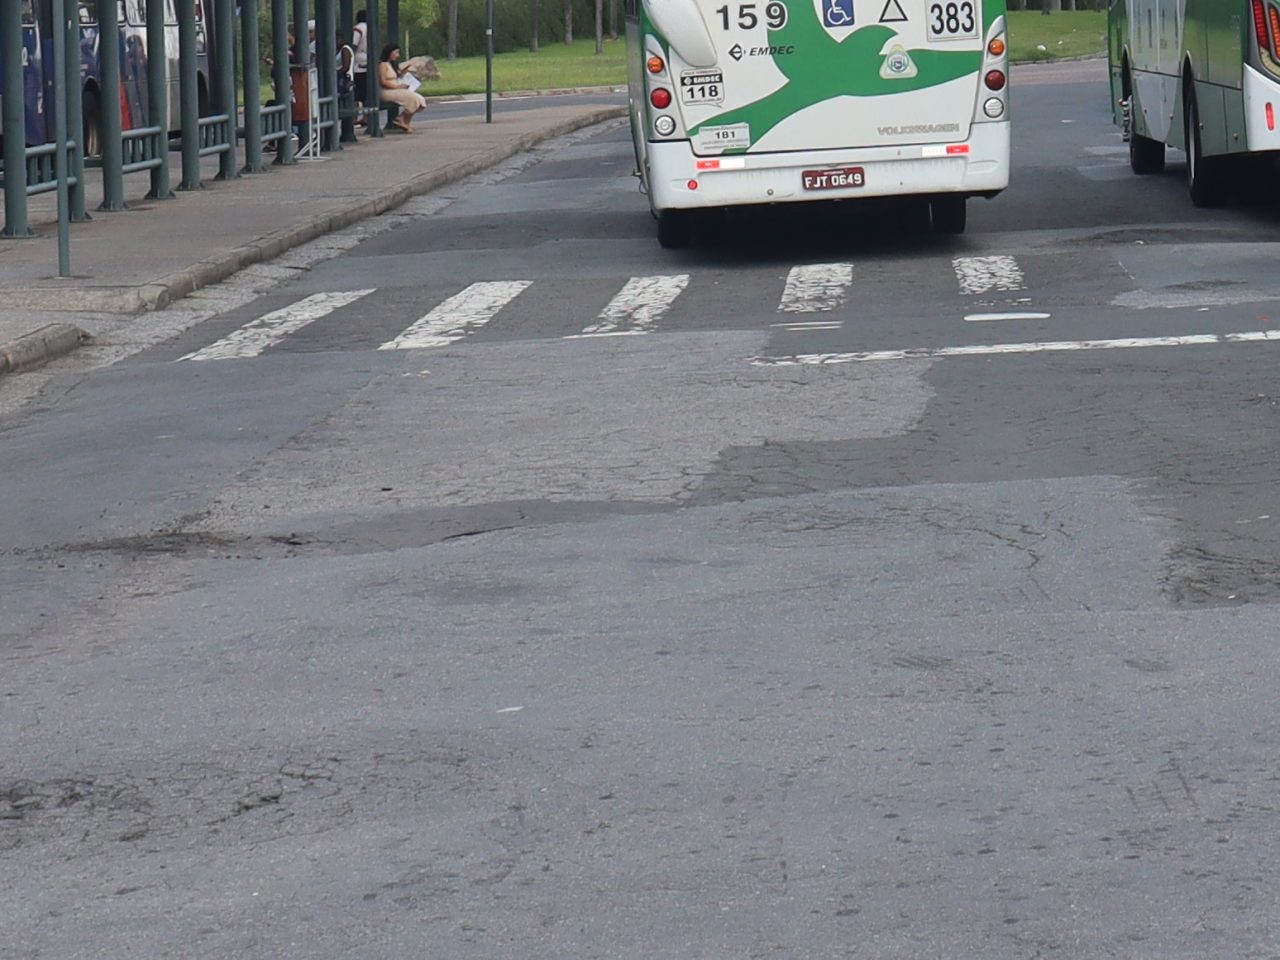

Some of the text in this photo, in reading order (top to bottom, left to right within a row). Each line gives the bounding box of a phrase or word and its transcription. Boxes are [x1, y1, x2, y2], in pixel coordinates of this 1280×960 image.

[716, 2, 787, 30] 159
[930, 1, 975, 35] 383
[749, 45, 795, 56] EMDEC
[686, 85, 719, 99] 118
[715, 131, 736, 140] 181
[805, 173, 862, 188] FJT 0649
